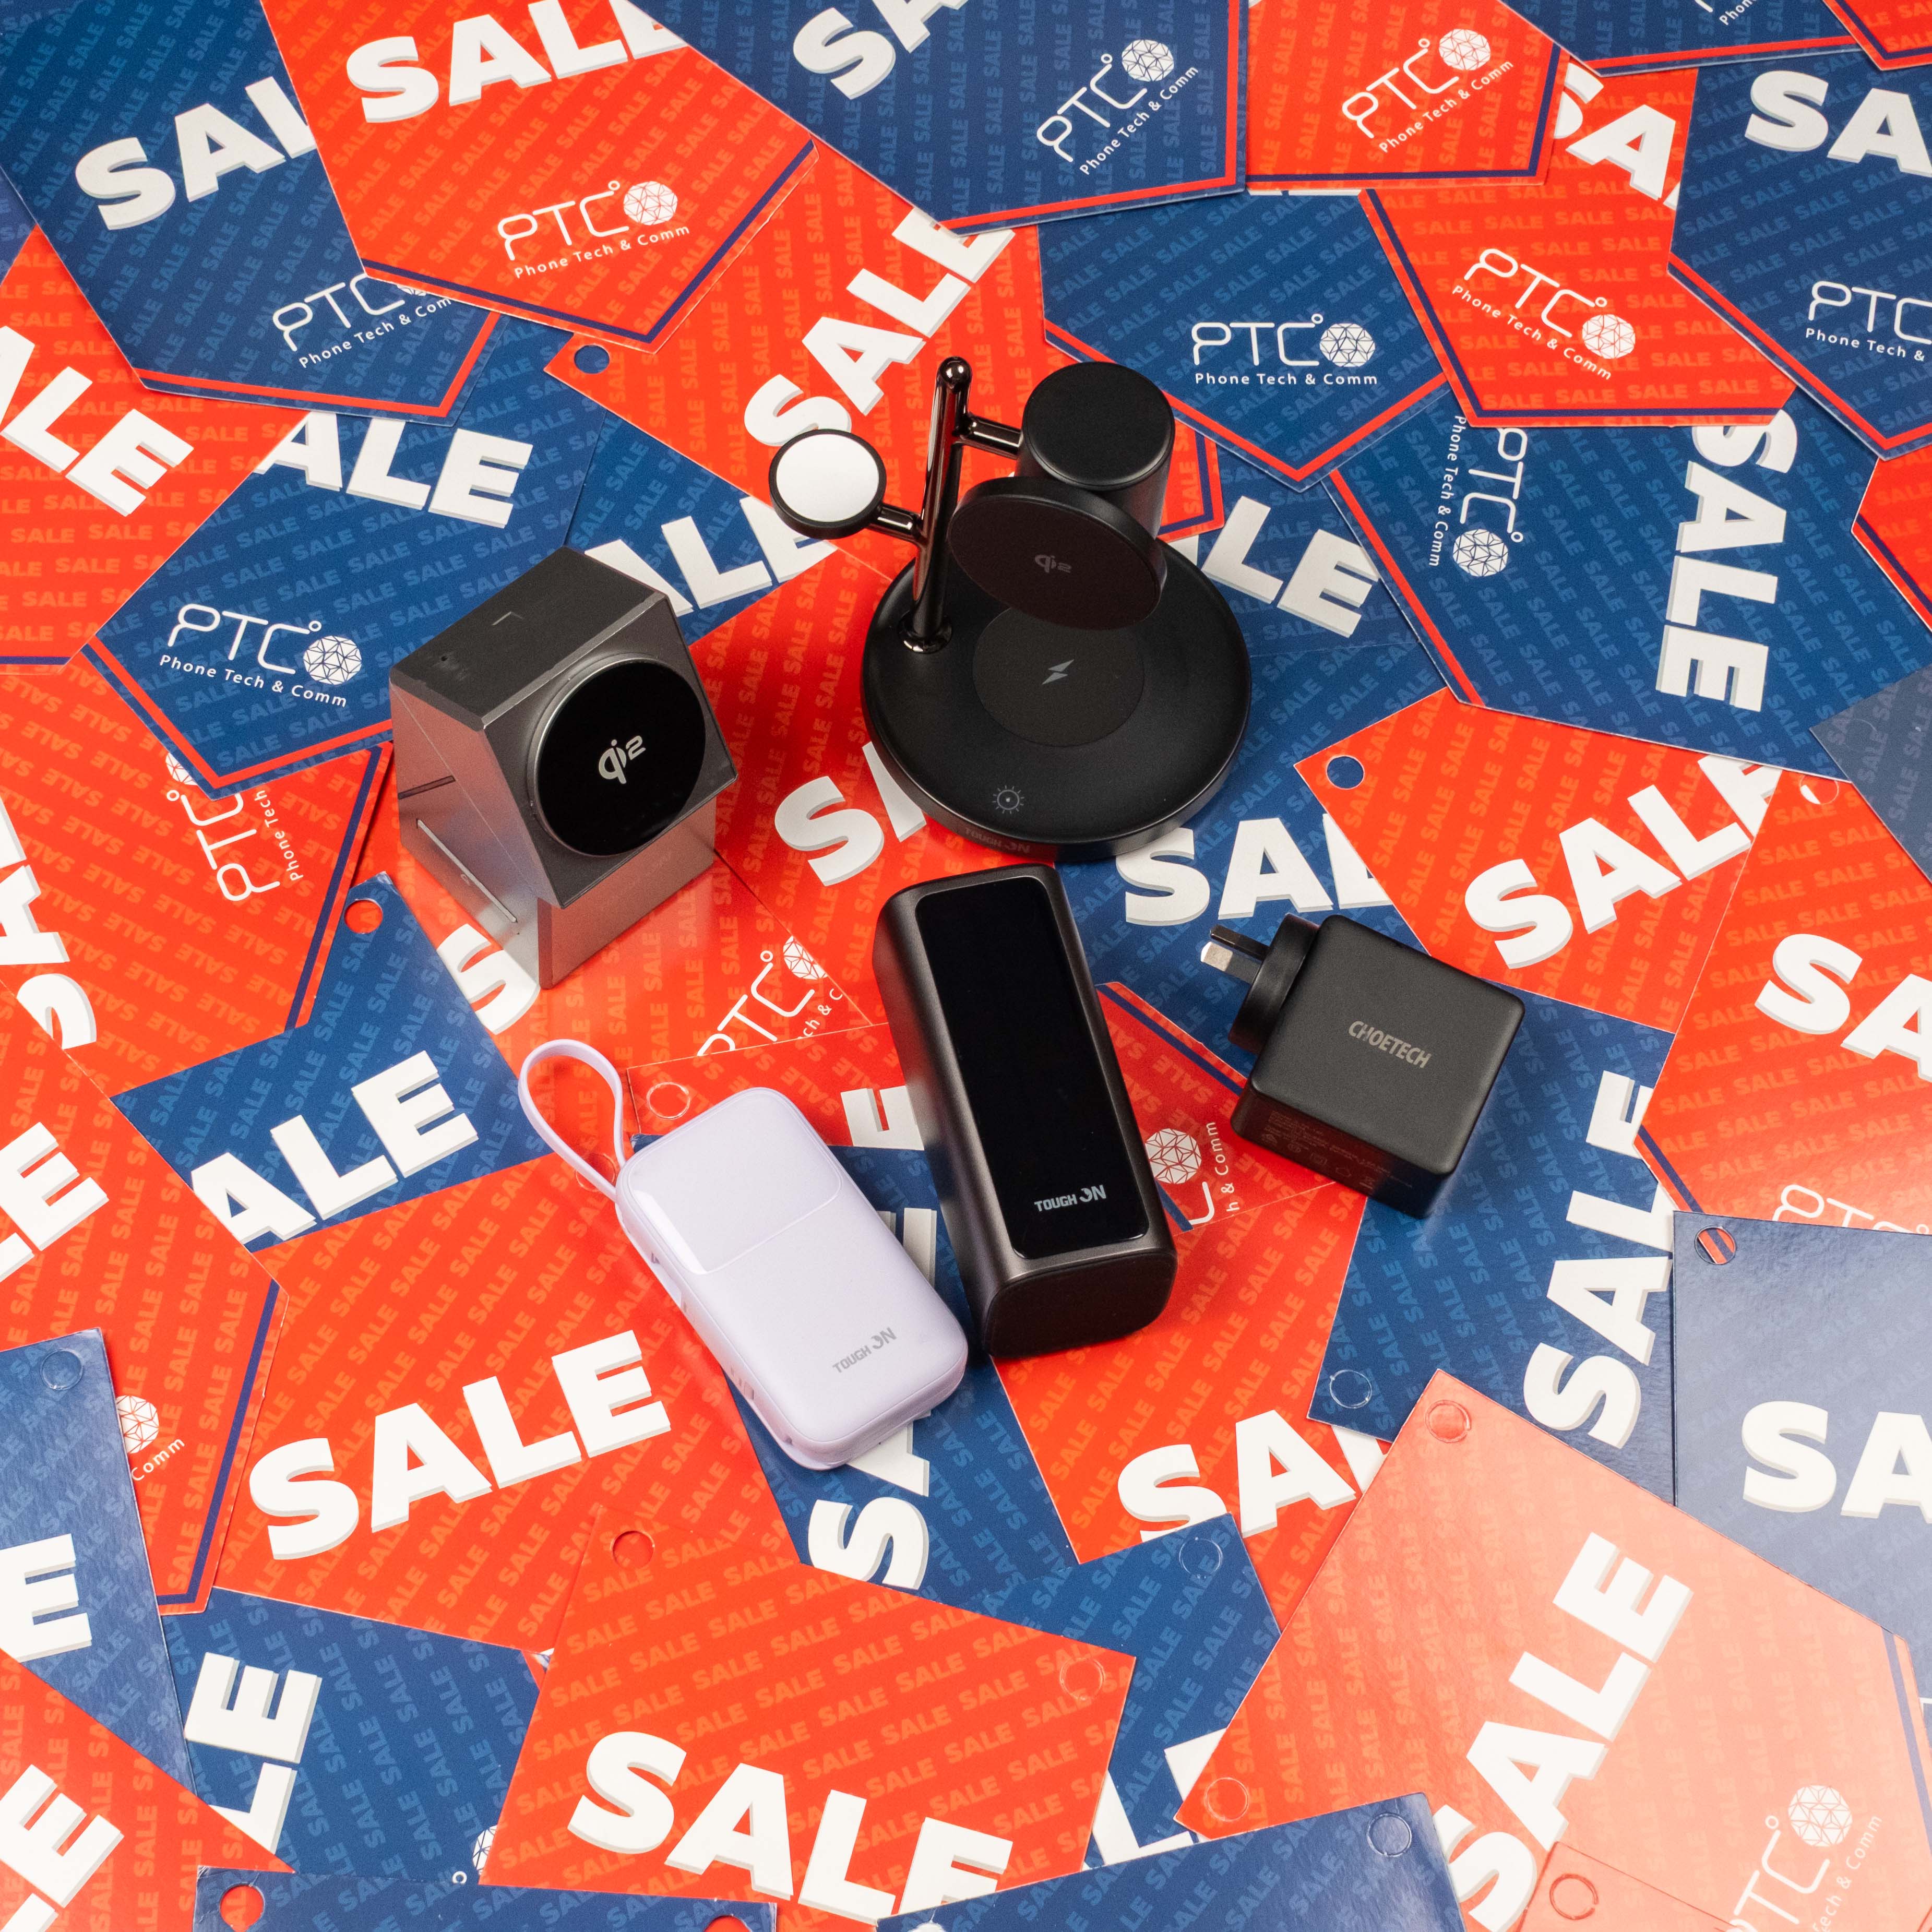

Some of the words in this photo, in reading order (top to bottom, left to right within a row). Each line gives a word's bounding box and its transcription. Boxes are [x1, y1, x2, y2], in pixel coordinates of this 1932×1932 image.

[1719, 0, 1757, 25] Phon
[18, 43, 56, 89] SALE
[793, 0, 968, 99] SA
[1343, 31, 1367, 78] SALE
[89, 56, 127, 102] SALE
[949, 62, 967, 109] SALE
[1304, 57, 1328, 103] SALE
[1343, 49, 1458, 137] PTC
[914, 94, 932, 141] SALE
[1037, 64, 1147, 162] PTC
[1080, 139, 1120, 175] Phone
[1117, 113, 1149, 137] Tech
[1149, 101, 1161, 111] &
[1160, 67, 1198, 99] Comm
[1380, 123, 1423, 152] Phone
[1423, 100, 1456, 121] Tech
[1458, 90, 1470, 99] &
[1472, 62, 1513, 89] Comm
[1745, 71, 1932, 177] SA
[13, 128, 50, 174] SALE
[76, 77, 316, 230] SAL
[452, 132, 495, 175] SALE
[504, 118, 547, 162] SALE
[950, 120, 968, 167] SALE
[362, 195, 405, 240] SALE
[805, 194, 824, 242] SALE
[1740, 181, 1795, 209] SALE
[498, 192, 628, 260] PTC
[1485, 216, 1543, 229] SALE
[1789, 227, 1845, 256] SALE
[152, 244, 189, 291] SALE
[515, 259, 567, 278] Phone
[574, 245, 613, 261] Tech
[621, 240, 630, 250] &
[638, 227, 689, 245] Comm
[1531, 242, 1590, 256] SALE
[225, 257, 263, 304] SALE
[1105, 265, 1156, 302] SALE
[1214, 265, 1266, 303] SALE
[1465, 249, 1594, 337] PTC
[299, 342, 352, 368] Phone
[354, 322, 394, 342] Tech
[399, 314, 411, 325] &
[415, 297, 452, 317] Com
[711, 302, 730, 351] SALE
[1004, 308, 1025, 357] SALE
[1192, 323, 1319, 365] PTC
[1453, 285, 1500, 317] Phone
[1508, 315, 1541, 340] Tech
[1547, 339, 1557, 349] &
[1564, 348, 1611, 379] Comm
[1806, 328, 1859, 348] Phone
[1867, 340, 1905, 357] Tech
[1914, 350, 1924, 361] &
[1196, 373, 1249, 384] Phone
[1257, 374, 1296, 384] Tech
[1305, 374, 1315, 384] &
[1323, 374, 1377, 384] Comm
[1651, 352, 1711, 366] SALE
[720, 363, 739, 413] SALE
[185, 426, 248, 442] SALE
[1448, 416, 1466, 460] Phone
[254, 410, 533, 528] ALE
[1441, 468, 1458, 499] Tech
[1549, 460, 1591, 509] SALE
[44, 495, 107, 510] SALE
[1438, 506, 1451, 515] &
[236, 517, 300, 547] SALE
[1429, 521, 1448, 566] Comm
[1591, 515, 1633, 565] SALE
[56, 558, 120, 574] SALE
[348, 542, 410, 573] SALE
[403, 554, 467, 586] SALE
[1168, 496, 1378, 637] LE
[1583, 560, 1626, 612] SALE
[168, 604, 309, 674] PTC
[160, 655, 216, 677] Phone
[225, 669, 264, 688] Tech
[272, 681, 283, 693] &
[292, 685, 346, 707] Comm
[1520, 644, 1562, 696] SALE
[21, 721, 82, 759] SALE
[1441, 723, 1474, 777] SALE
[255, 791, 278, 827] Tech
[1498, 801, 1531, 857] SALE
[62, 816, 124, 854] SALE
[275, 831, 303, 880] Phone
[1758, 840, 1820, 864] SALE
[83, 863, 145, 903] SALE
[1116, 814, 1392, 925] SAL
[1798, 902, 1861, 928] SALE
[175, 944, 238, 983] SALE
[1616, 957, 1650, 1015] SALE
[314, 981, 354, 1041] SALE
[798, 1020, 820, 1040] ch
[818, 1005, 831, 1015] &
[1756, 934, 1932, 1081] SA
[1348, 1020, 1432, 1068] CHOETECH
[1660, 1088, 1724, 1115] SALE
[175, 1106, 217, 1168] SALE
[191, 1051, 479, 1244] ALE
[1207, 1122, 1229, 1175] Comm
[1034, 1194, 1078, 1212] TOUGH
[1221, 1184, 1234, 1192] &
[129, 1289, 163, 1353] SALE
[348, 1304, 398, 1364] SALE
[832, 1345, 872, 1373] TOUGH
[1087, 1351, 1135, 1412] SALE
[1166, 1379, 1213, 1440] SALE
[131, 1440, 184, 1482] Comm
[250, 1331, 670, 1558] SALE
[1742, 1401, 1932, 1524] SA
[437, 1545, 489, 1608] SALE
[708, 1599, 778, 1638] SALE
[1193, 1606, 1242, 1670] SALE
[375, 1655, 418, 1722] SALE
[550, 1667, 621, 1707] SALE
[756, 1669, 825, 1708] SALE
[881, 1705, 951, 1745] SALE
[1357, 1710, 1385, 1778] SALE
[184, 1653, 322, 1854] LE
[414, 1728, 458, 1796] SALE
[1846, 1816, 1882, 1869] Comm
